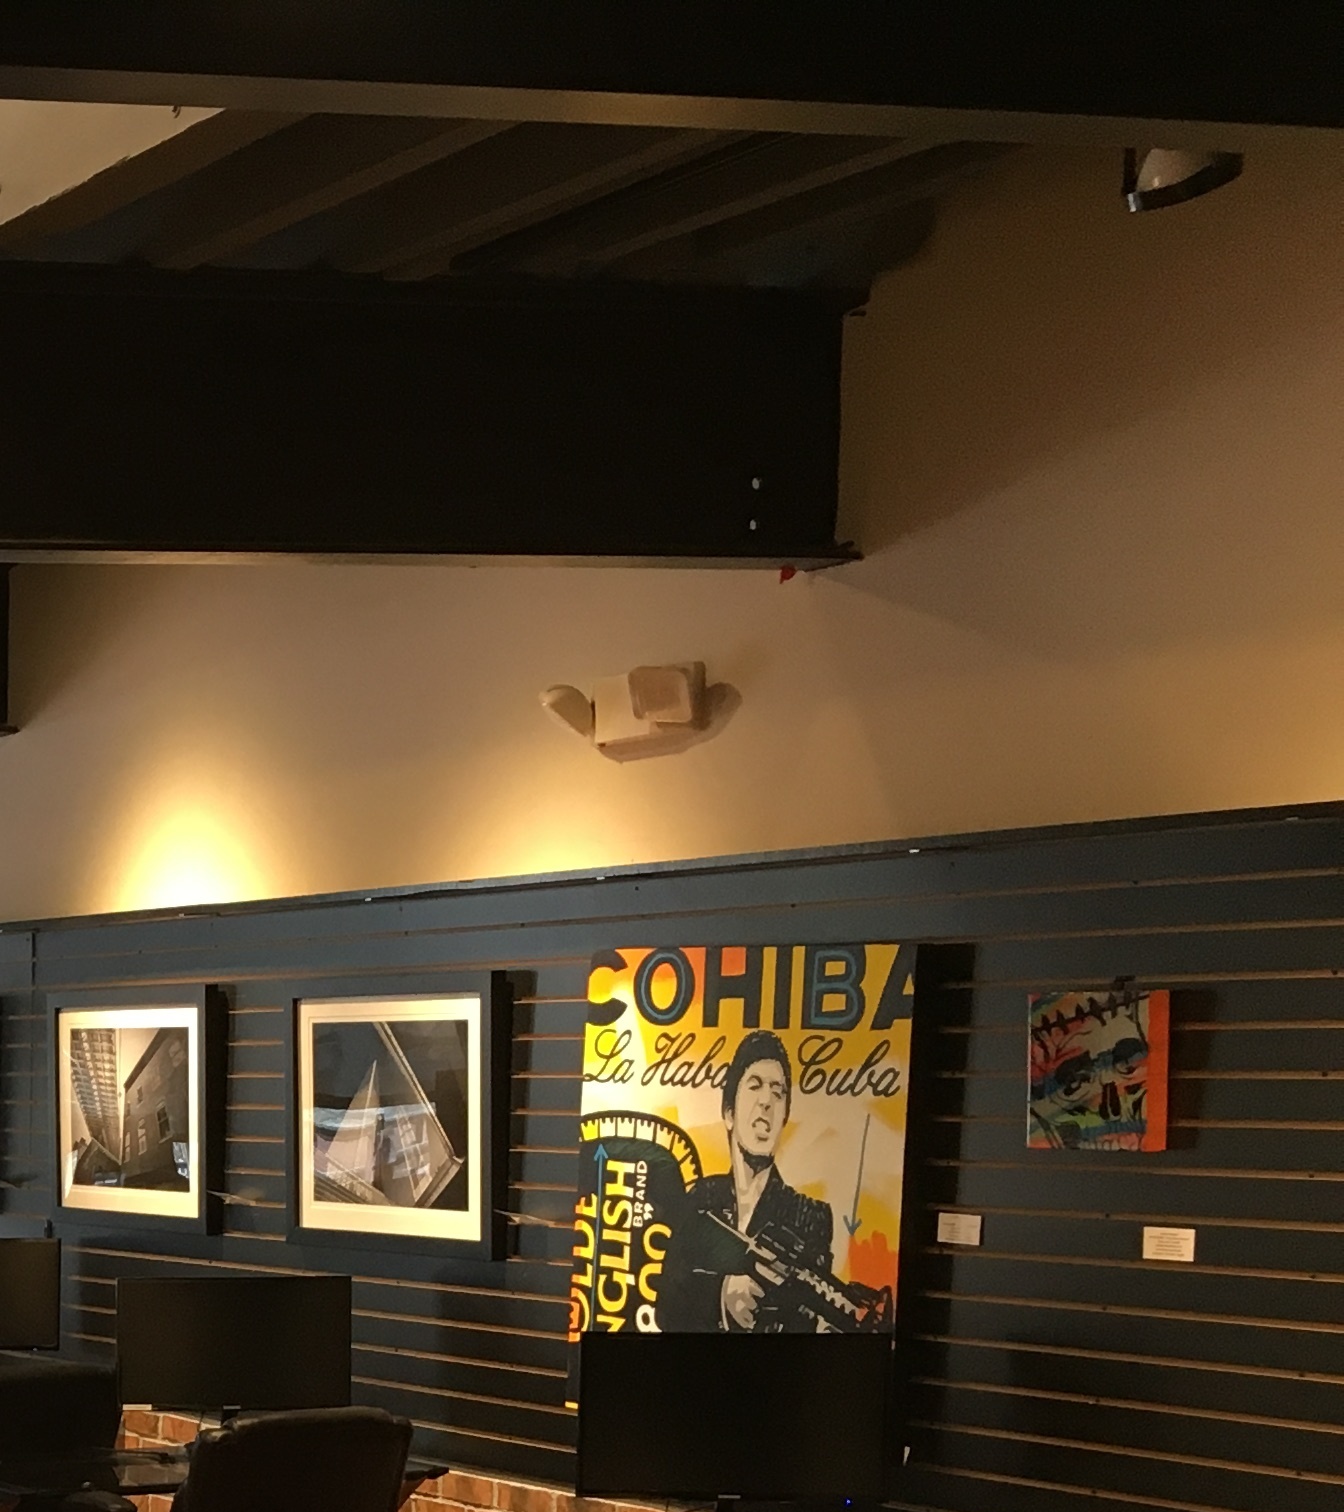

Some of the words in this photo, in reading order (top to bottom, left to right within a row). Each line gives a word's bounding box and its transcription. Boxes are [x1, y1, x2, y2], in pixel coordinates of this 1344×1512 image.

[585, 942, 916, 1031] COHIBA
[584, 1028, 636, 1085] La
[797, 1034, 902, 1099] Cuba
[633, 1160, 648, 1228] BRAND
